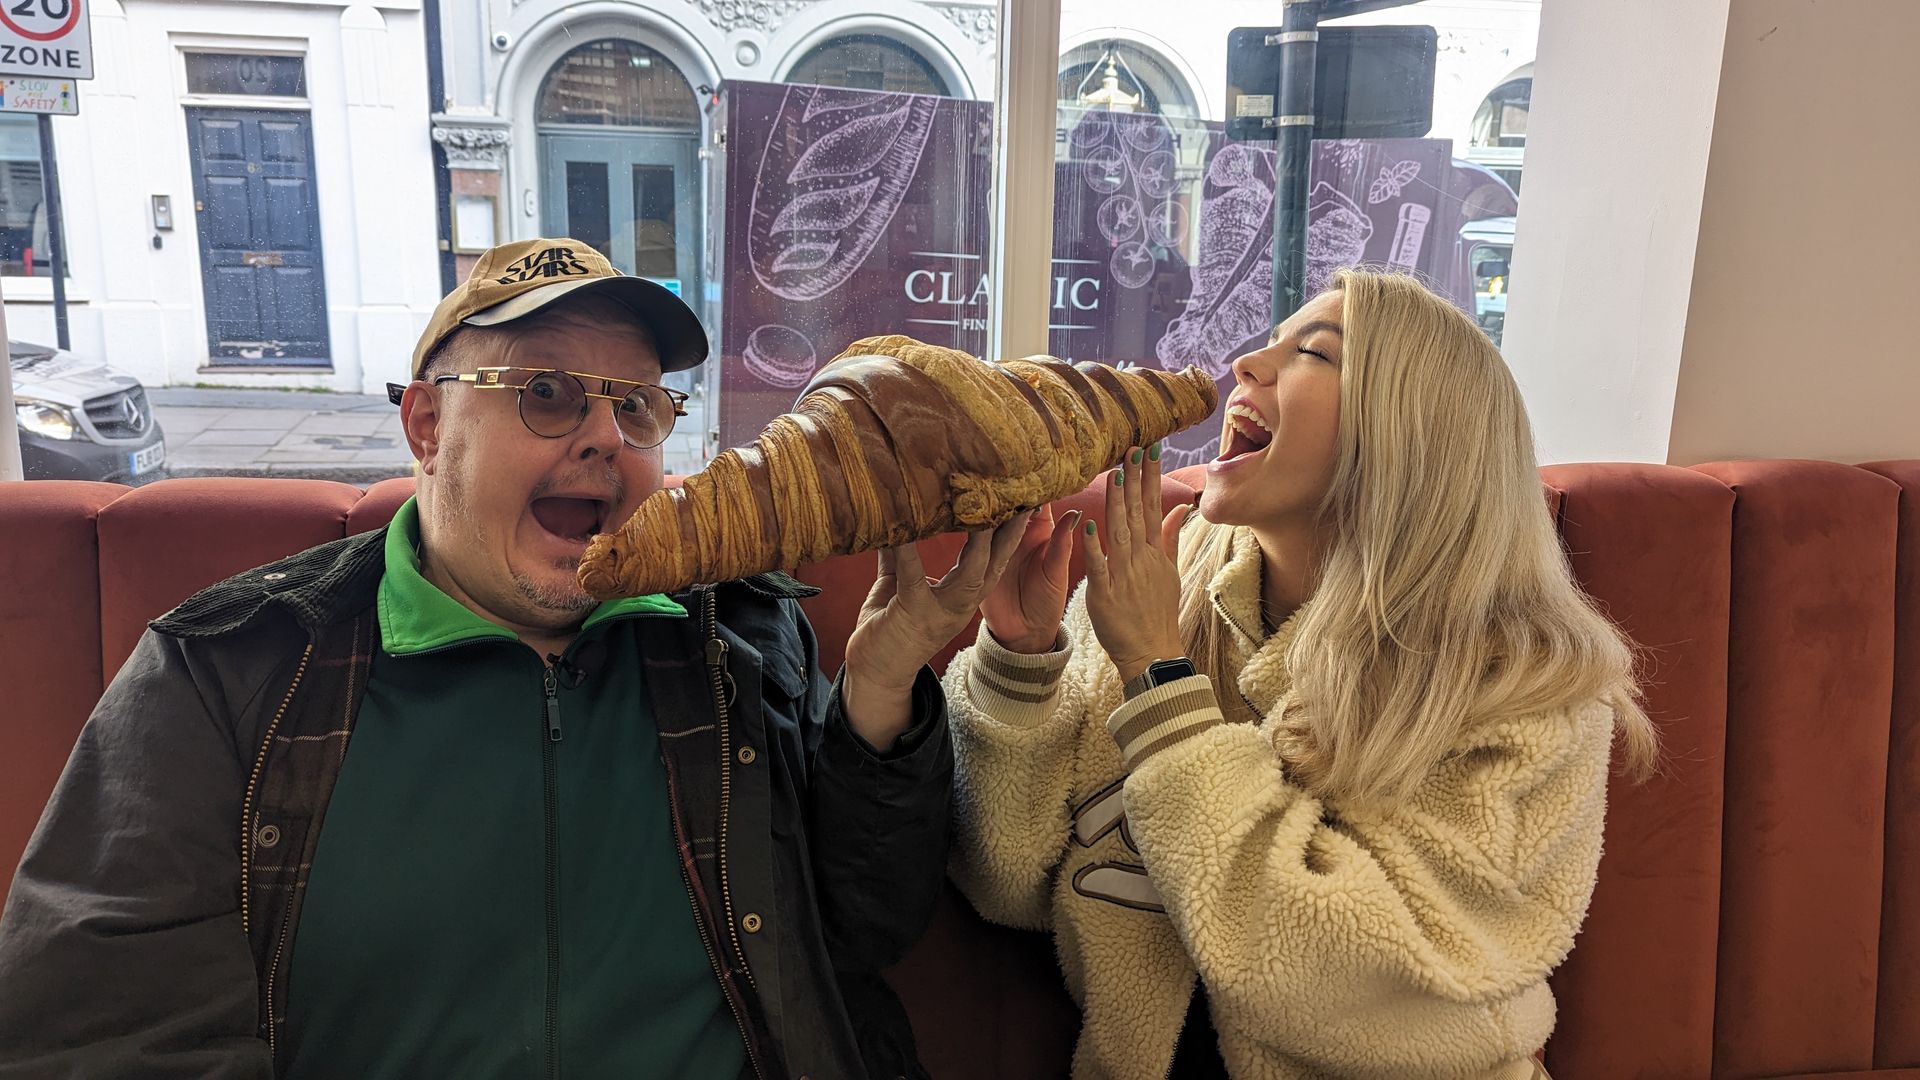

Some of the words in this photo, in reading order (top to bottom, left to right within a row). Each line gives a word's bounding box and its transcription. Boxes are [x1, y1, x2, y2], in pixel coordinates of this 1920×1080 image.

[1, 45, 81, 69] ZONE
[14, 96, 57, 109] SAFETY
[497, 260, 589, 284] WARS
[506, 248, 577, 275] STAR
[904, 269, 1100, 310] CLAIC
[962, 318, 988, 331] FIN
